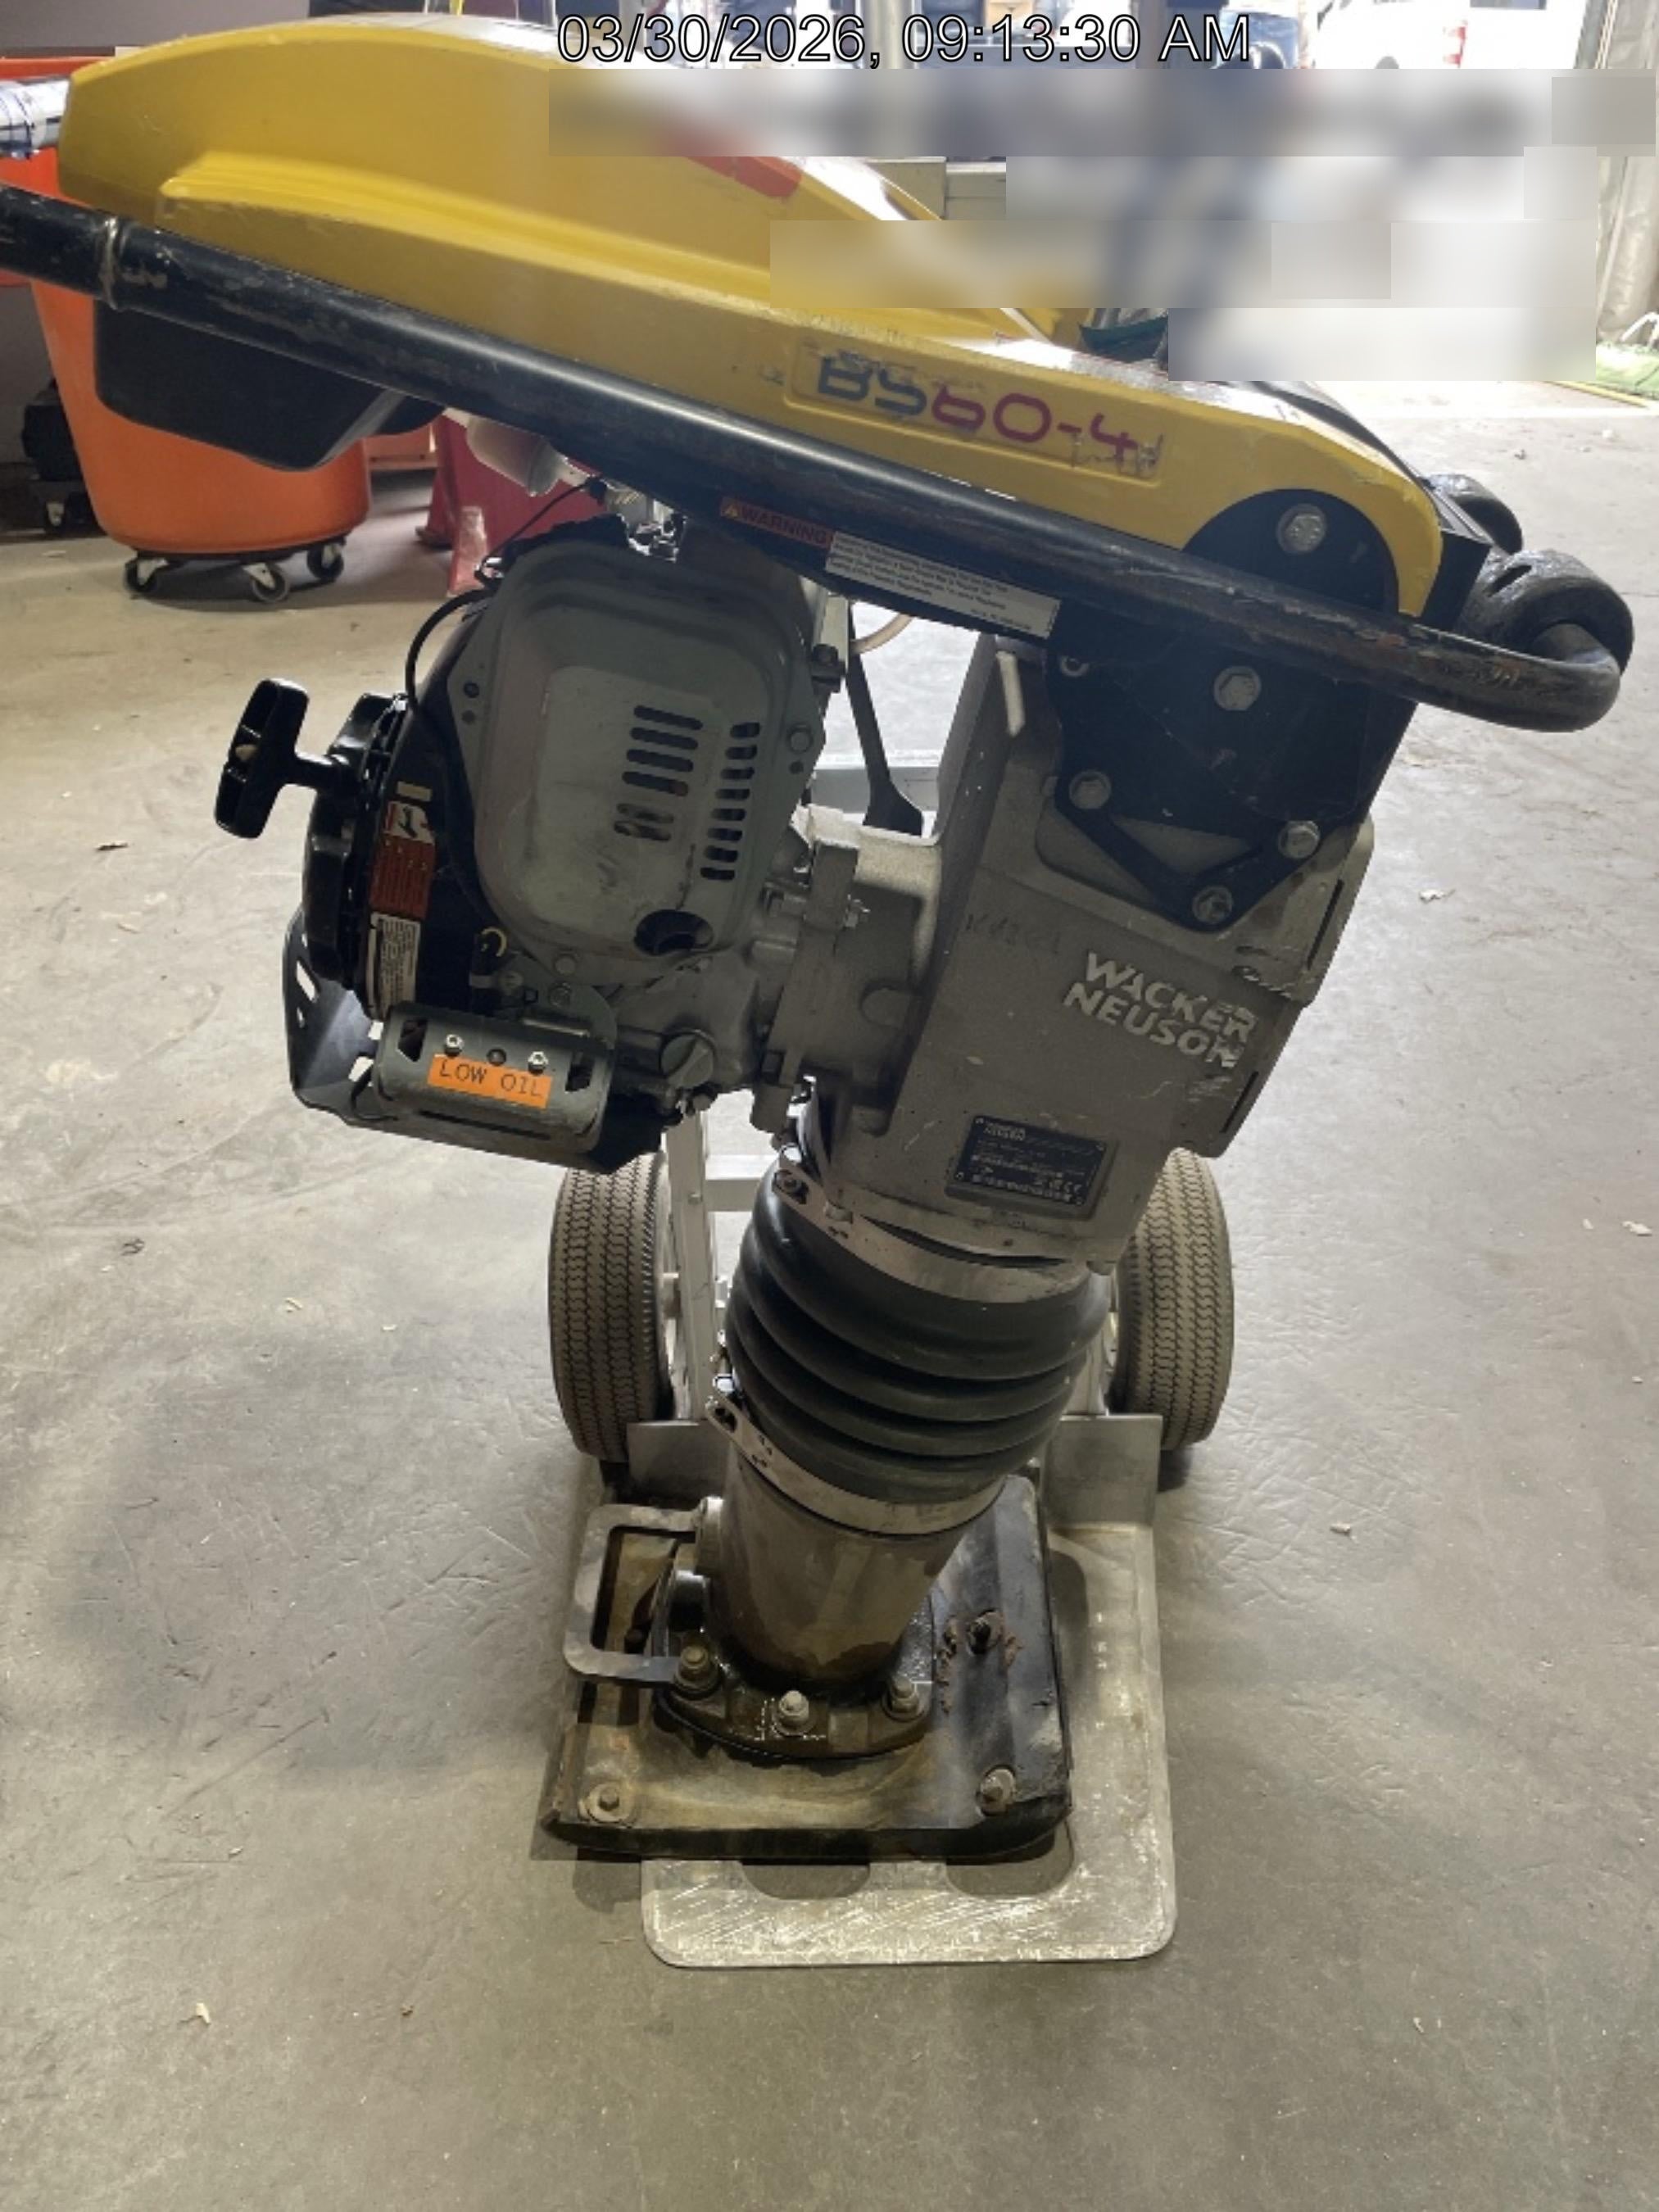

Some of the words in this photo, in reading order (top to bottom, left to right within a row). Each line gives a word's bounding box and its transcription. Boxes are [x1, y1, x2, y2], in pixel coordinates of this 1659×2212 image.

[740, 505, 827, 545] WARNING
[1063, 981, 1244, 1067] NEUSON
[1086, 952, 1258, 1043] WACKER
[439, 1058, 487, 1085] LOW
[501, 1073, 542, 1098] OIL
